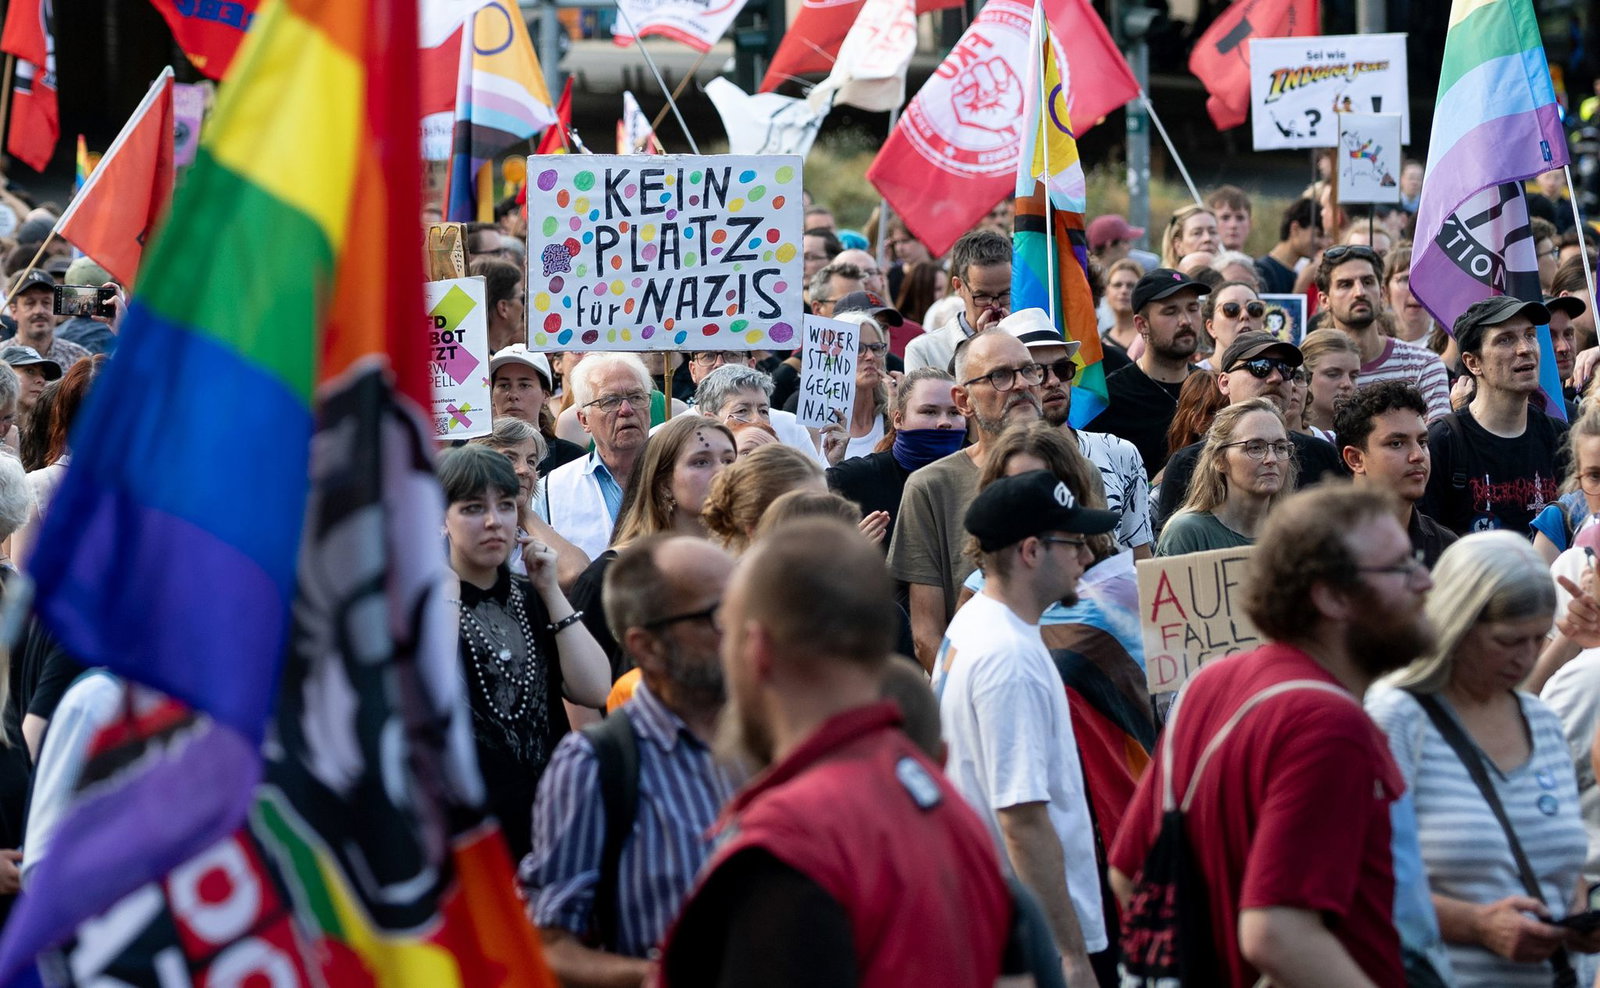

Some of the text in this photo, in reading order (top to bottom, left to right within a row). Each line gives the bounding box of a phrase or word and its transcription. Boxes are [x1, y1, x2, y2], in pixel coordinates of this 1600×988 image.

[1306, 50, 1346, 60] Sei wie
[605, 167, 732, 220] KEIN
[595, 214, 765, 277] PLATZ
[1438, 219, 1506, 291] TION
[576, 268, 783, 327] für NAZIS
[809, 325, 854, 352] WIDER
[808, 348, 851, 376] STAND
[806, 374, 850, 402] GEGEN
[1151, 557, 1249, 623] AUF
[1161, 620, 1257, 651] FALL
